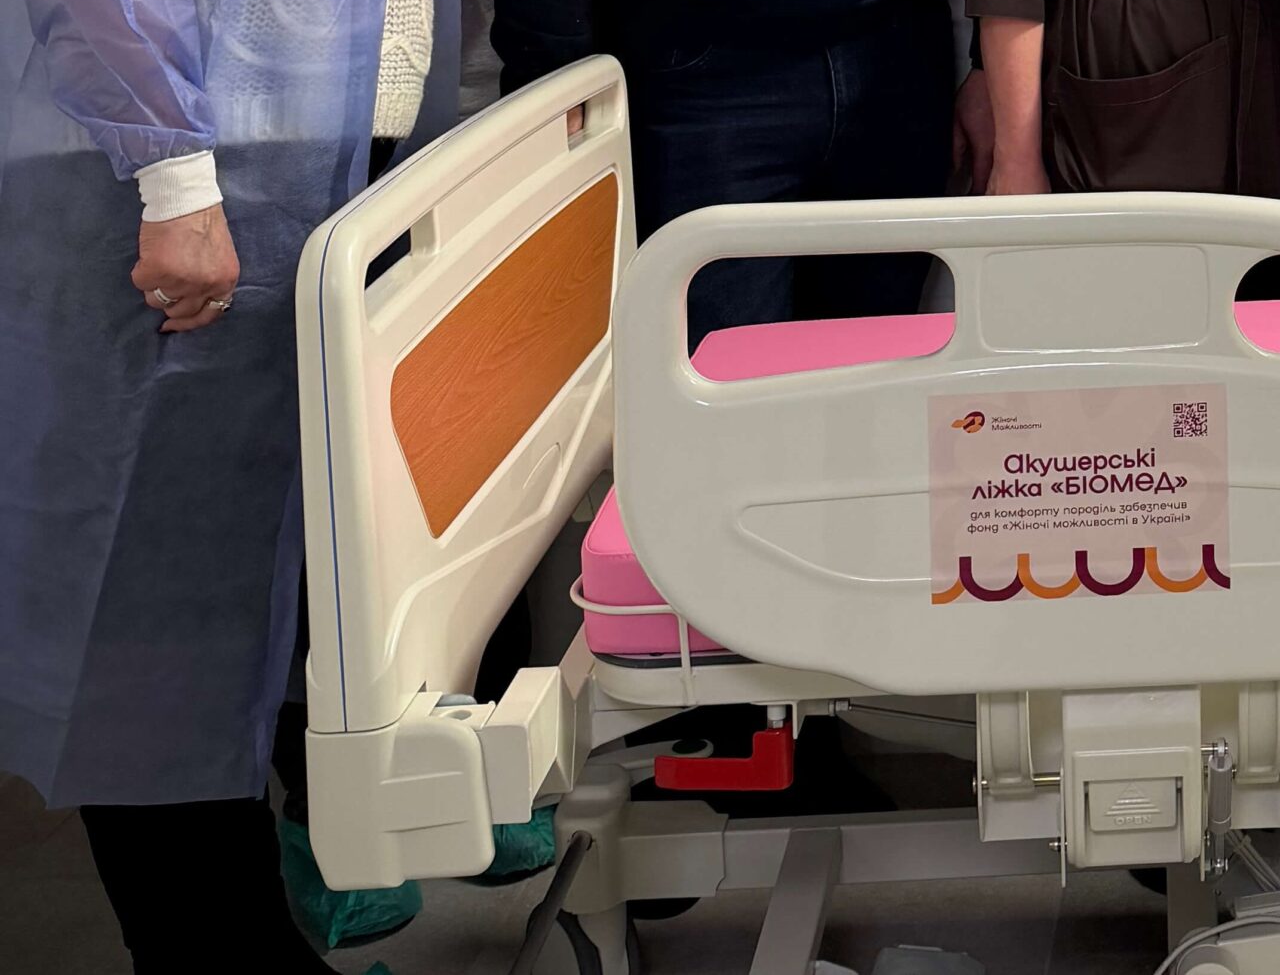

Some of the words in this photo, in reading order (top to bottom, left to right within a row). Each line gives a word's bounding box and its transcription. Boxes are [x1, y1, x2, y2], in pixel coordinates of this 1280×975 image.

[1003, 448, 1156, 477] Акушерські
[971, 479, 1042, 500] ліжка
[970, 510, 991, 521] для
[994, 506, 1060, 520] комфорту
[1063, 502, 1116, 516] породіль
[1119, 501, 1188, 514] забезпечив
[967, 521, 999, 534] фонд
[1002, 519, 1050, 531] «Жіночі
[1053, 515, 1129, 529] можливості
[1132, 516, 1138, 525] в
[1141, 512, 1191, 525] Україні»
[1114, 815, 1152, 826] OPEN
